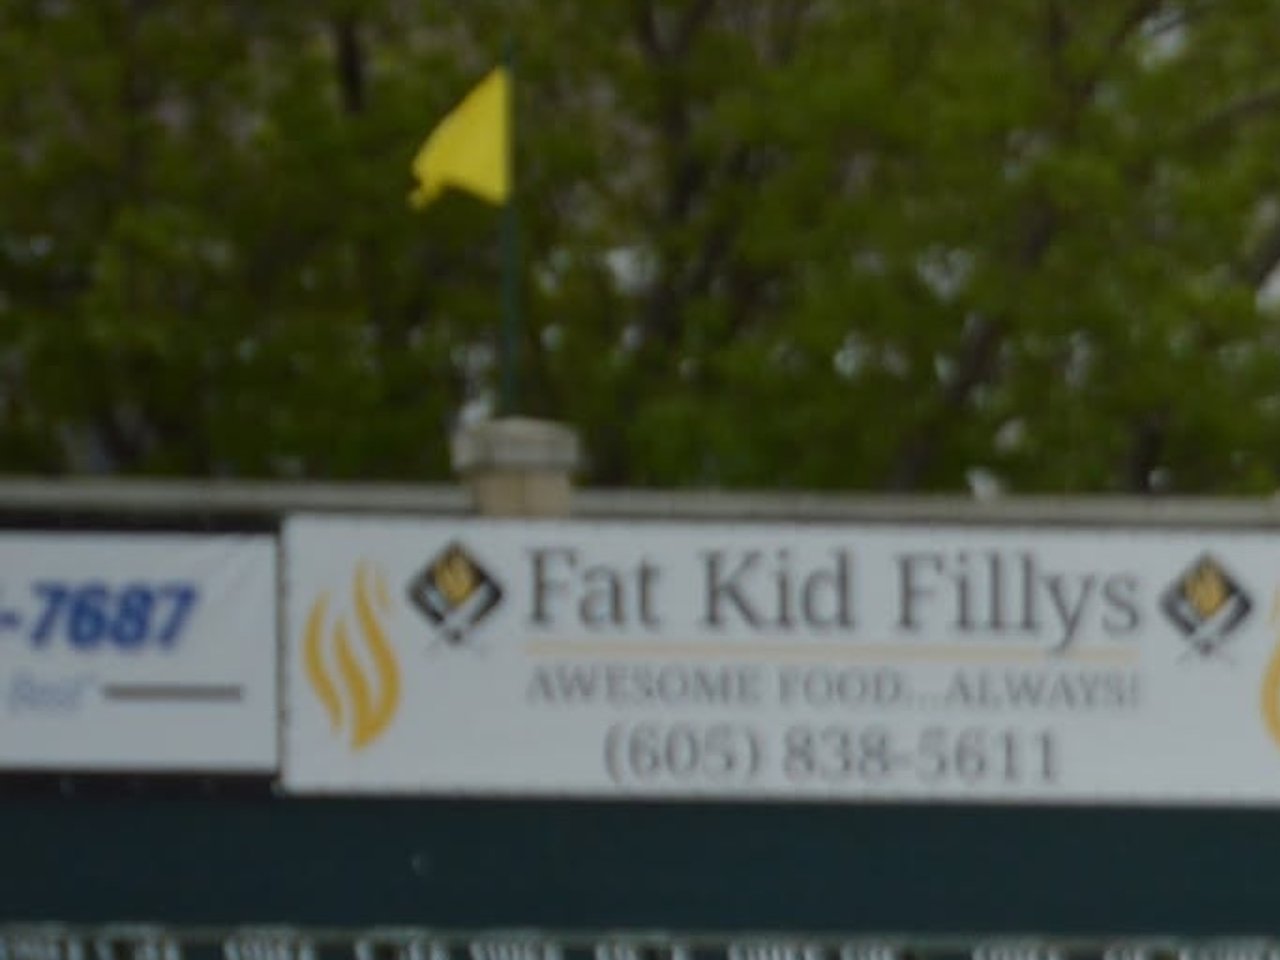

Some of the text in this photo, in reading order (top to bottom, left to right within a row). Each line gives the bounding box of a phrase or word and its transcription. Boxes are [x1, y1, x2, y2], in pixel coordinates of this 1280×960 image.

[0, 578, 198, 651] -7687
[527, 547, 1142, 652] Fat Kid Fillys
[526, 665, 758, 704] AWESOME
[602, 722, 1061, 784] (605) 838-5611
